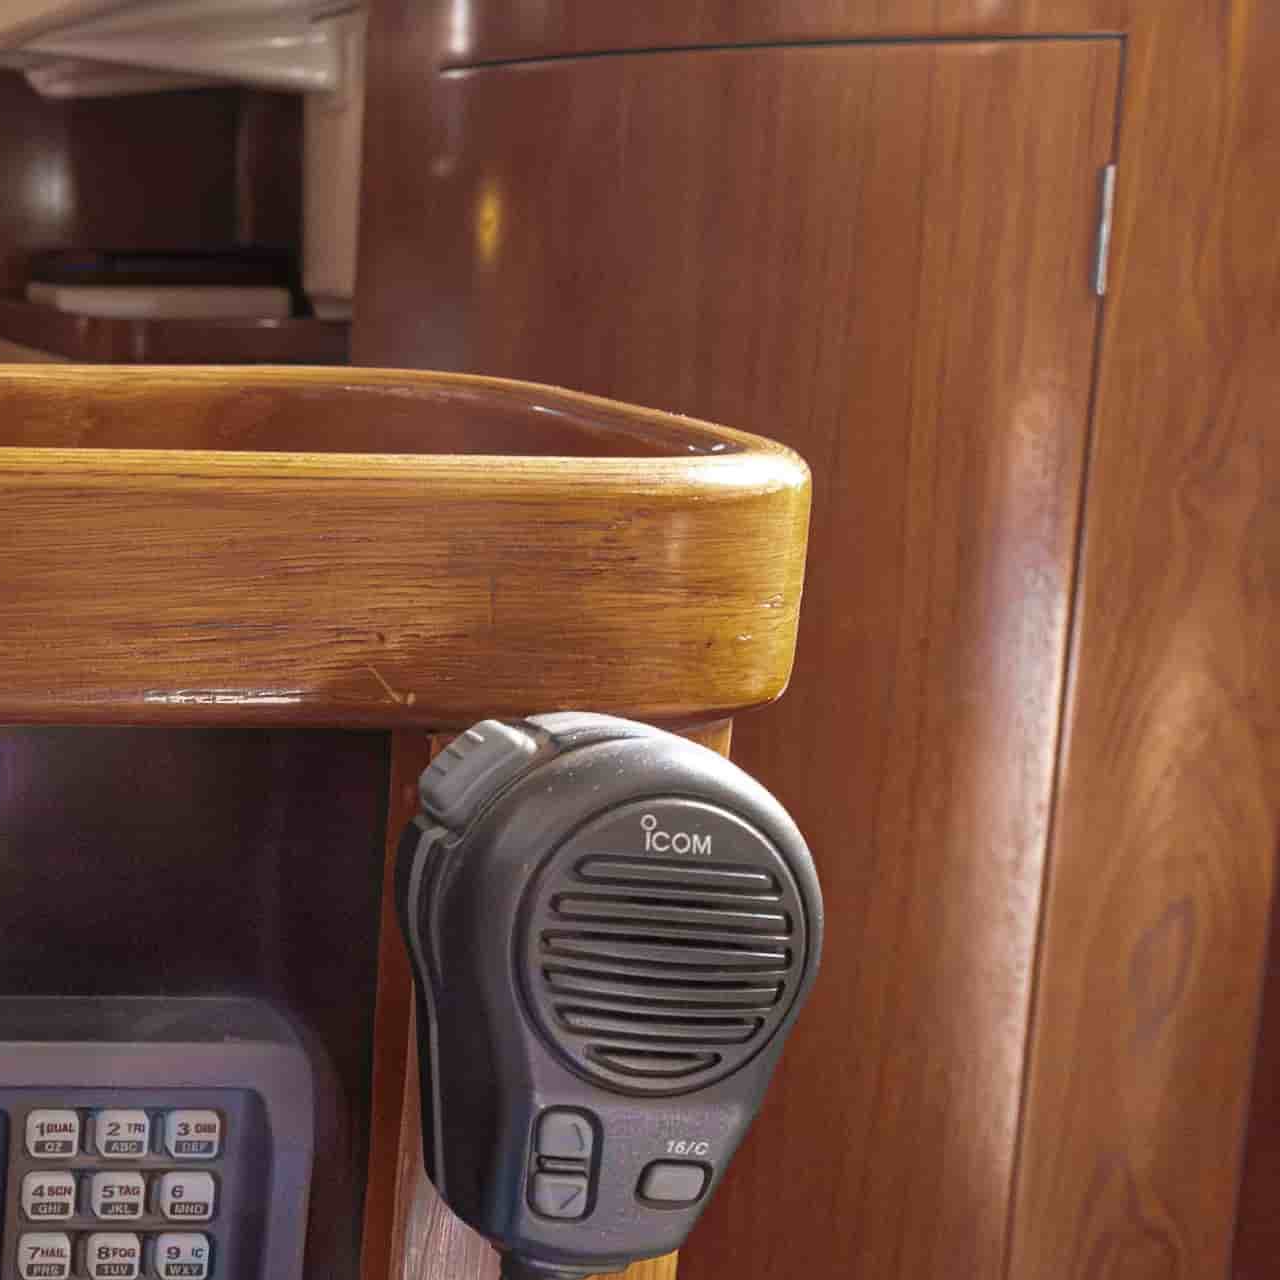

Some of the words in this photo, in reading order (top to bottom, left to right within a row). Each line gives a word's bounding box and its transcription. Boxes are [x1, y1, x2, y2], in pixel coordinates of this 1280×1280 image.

[106, 1122, 121, 1137] 2
[177, 1122, 190, 1137] 3
[665, 1140, 710, 1156] 16/C
[31, 1185, 45, 1198] 4
[101, 1185, 115, 1198] 5
[171, 1185, 184, 1198] 6
[28, 1247, 41, 1260] 7
[97, 1247, 111, 1260] 8
[167, 1246, 181, 1259] 9
